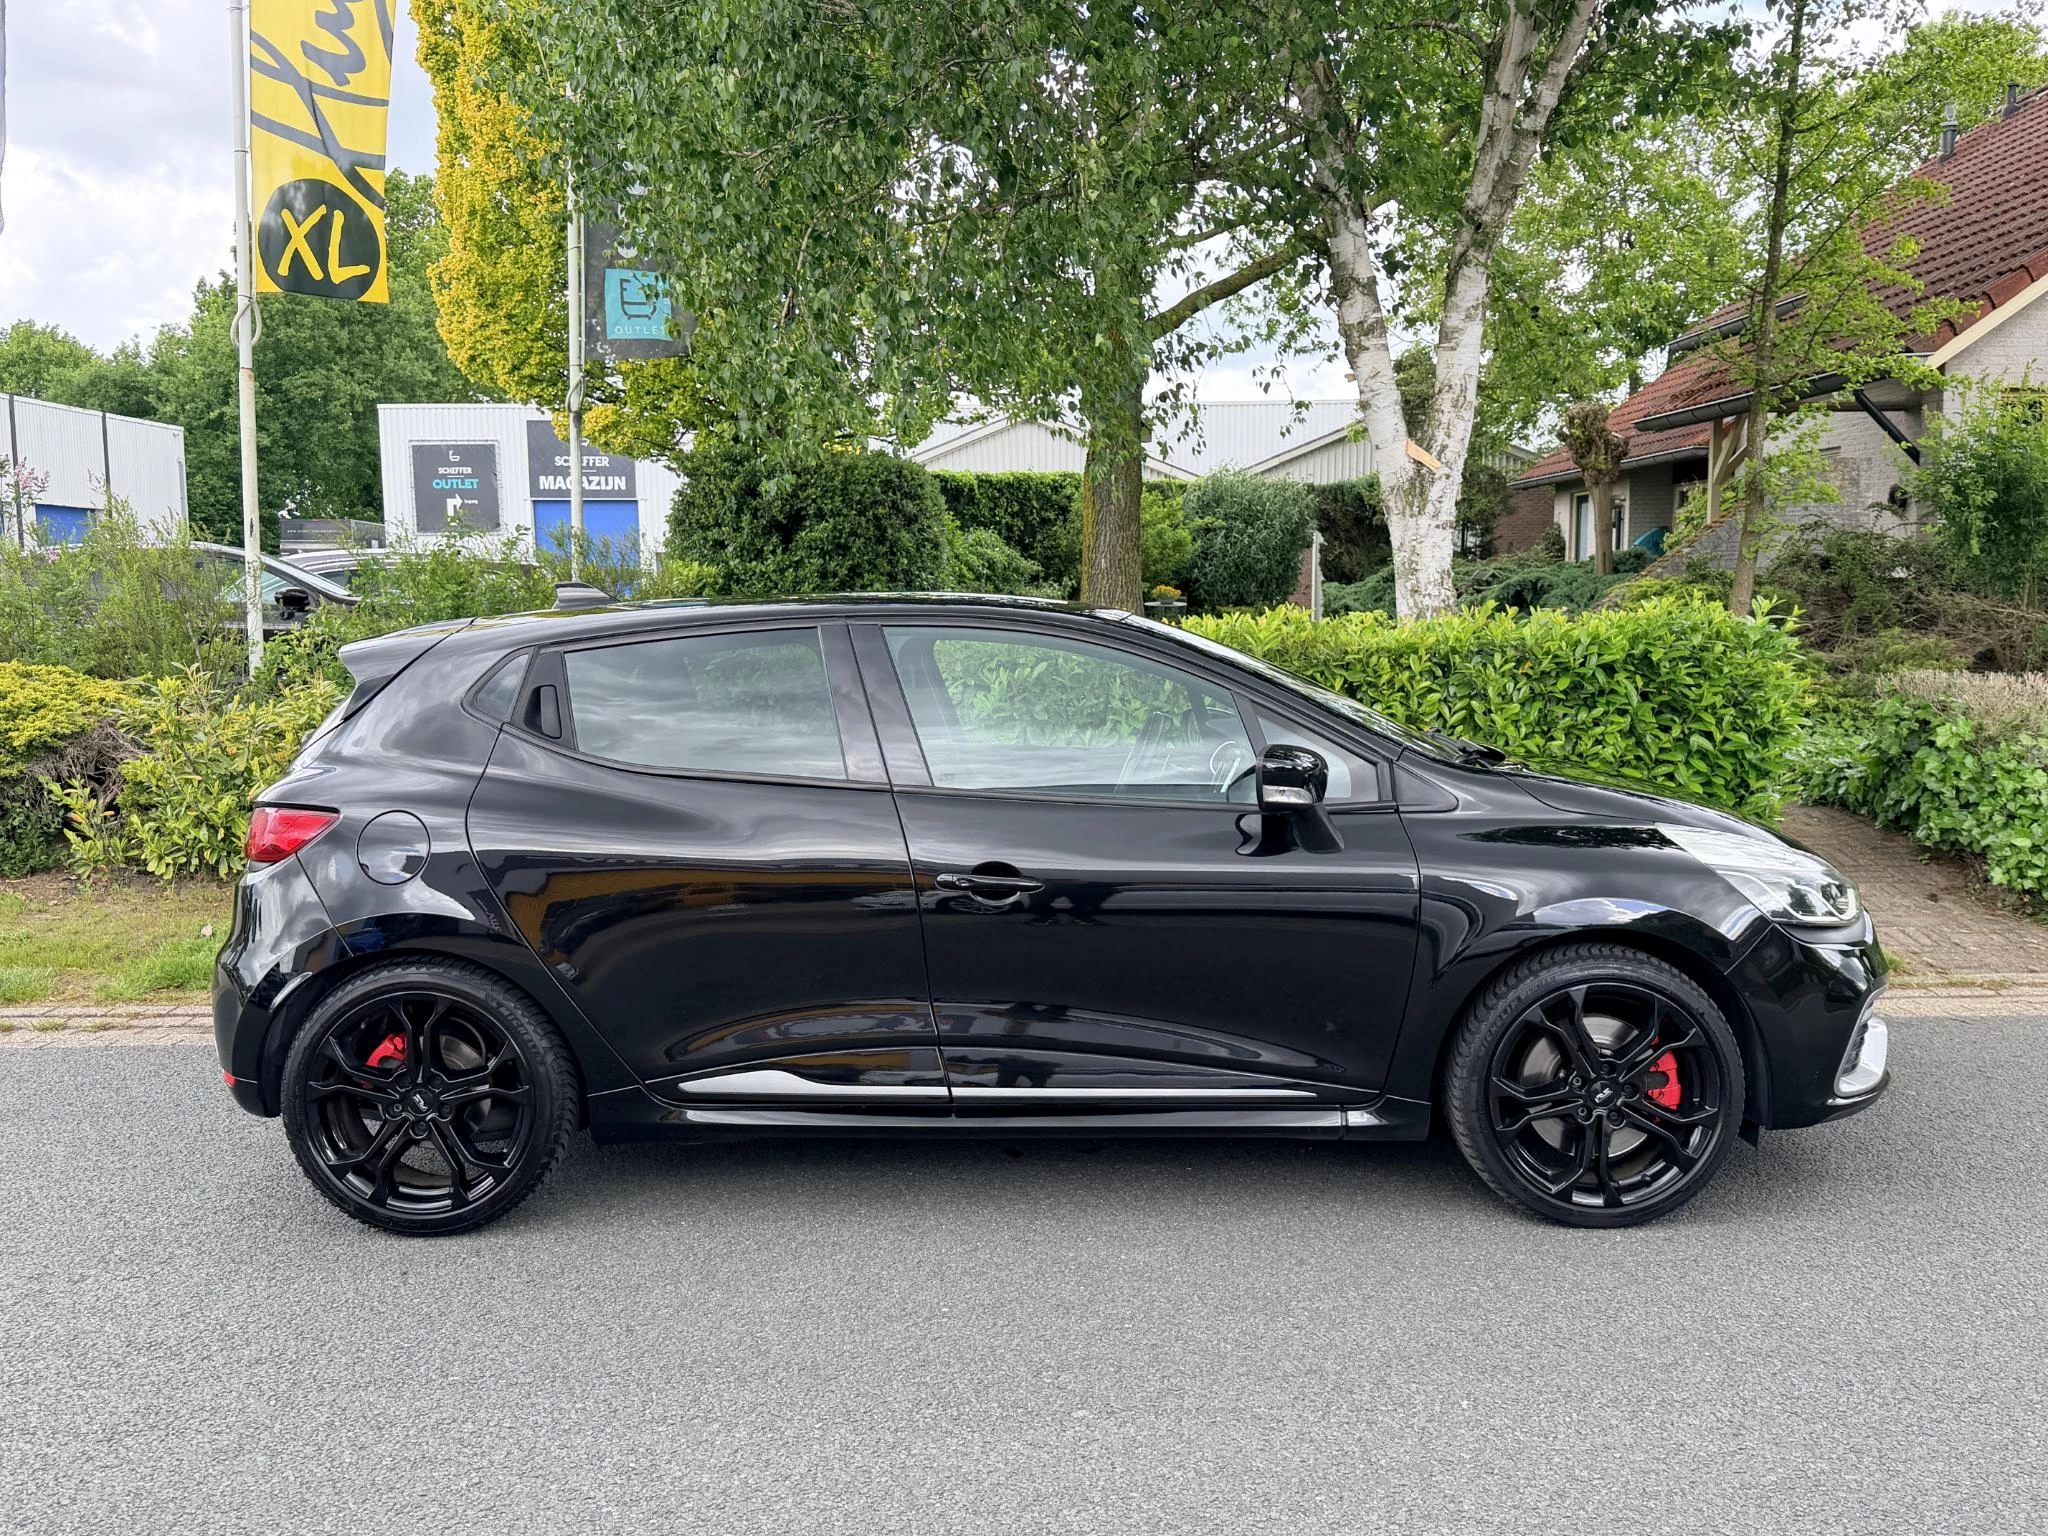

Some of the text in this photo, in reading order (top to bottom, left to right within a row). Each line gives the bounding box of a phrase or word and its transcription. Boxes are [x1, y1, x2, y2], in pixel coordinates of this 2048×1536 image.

[277, 204, 370, 284] XL
[438, 466, 472, 474] SCHEFFER
[432, 478, 479, 489] OUTLET
